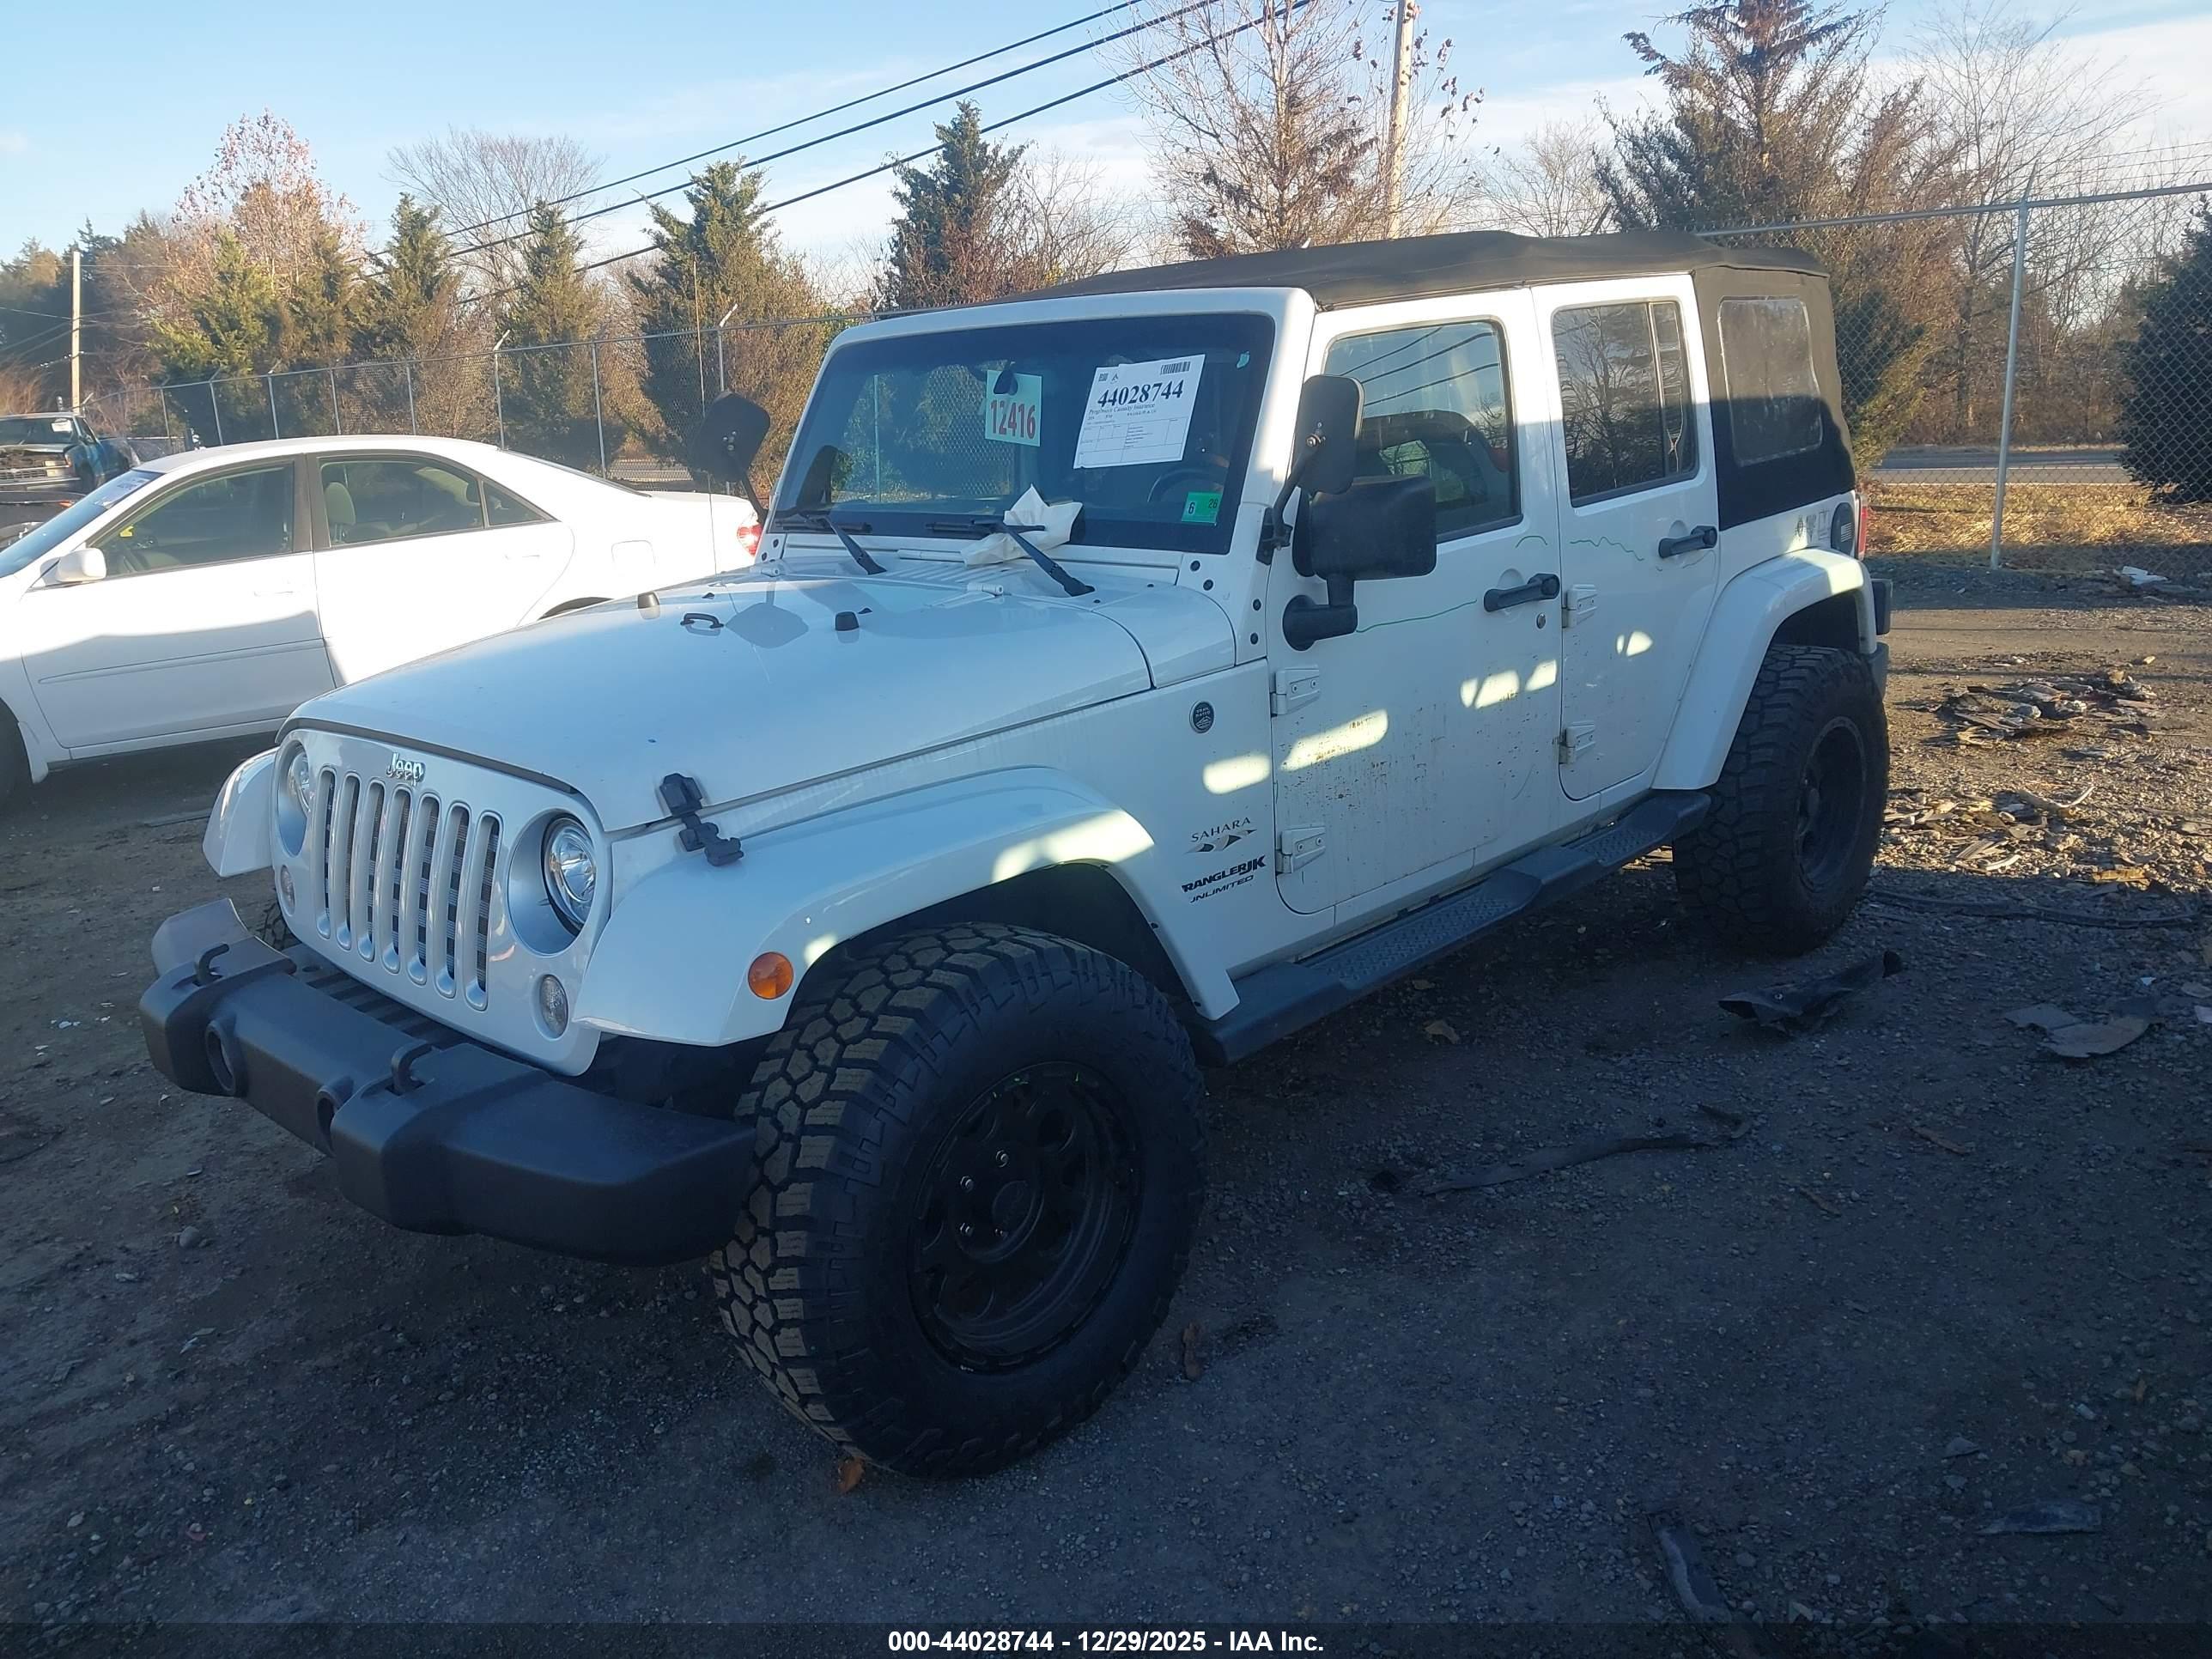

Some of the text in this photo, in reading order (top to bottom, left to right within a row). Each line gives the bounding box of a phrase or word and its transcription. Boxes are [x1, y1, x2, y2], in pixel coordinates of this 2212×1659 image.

[1097, 380, 1184, 407] 44028744
[991, 400, 1036, 439] 12416
[1188, 501, 1195, 514] 6
[386, 752, 423, 784] Jeep
[1191, 817, 1251, 842] SAHARA
